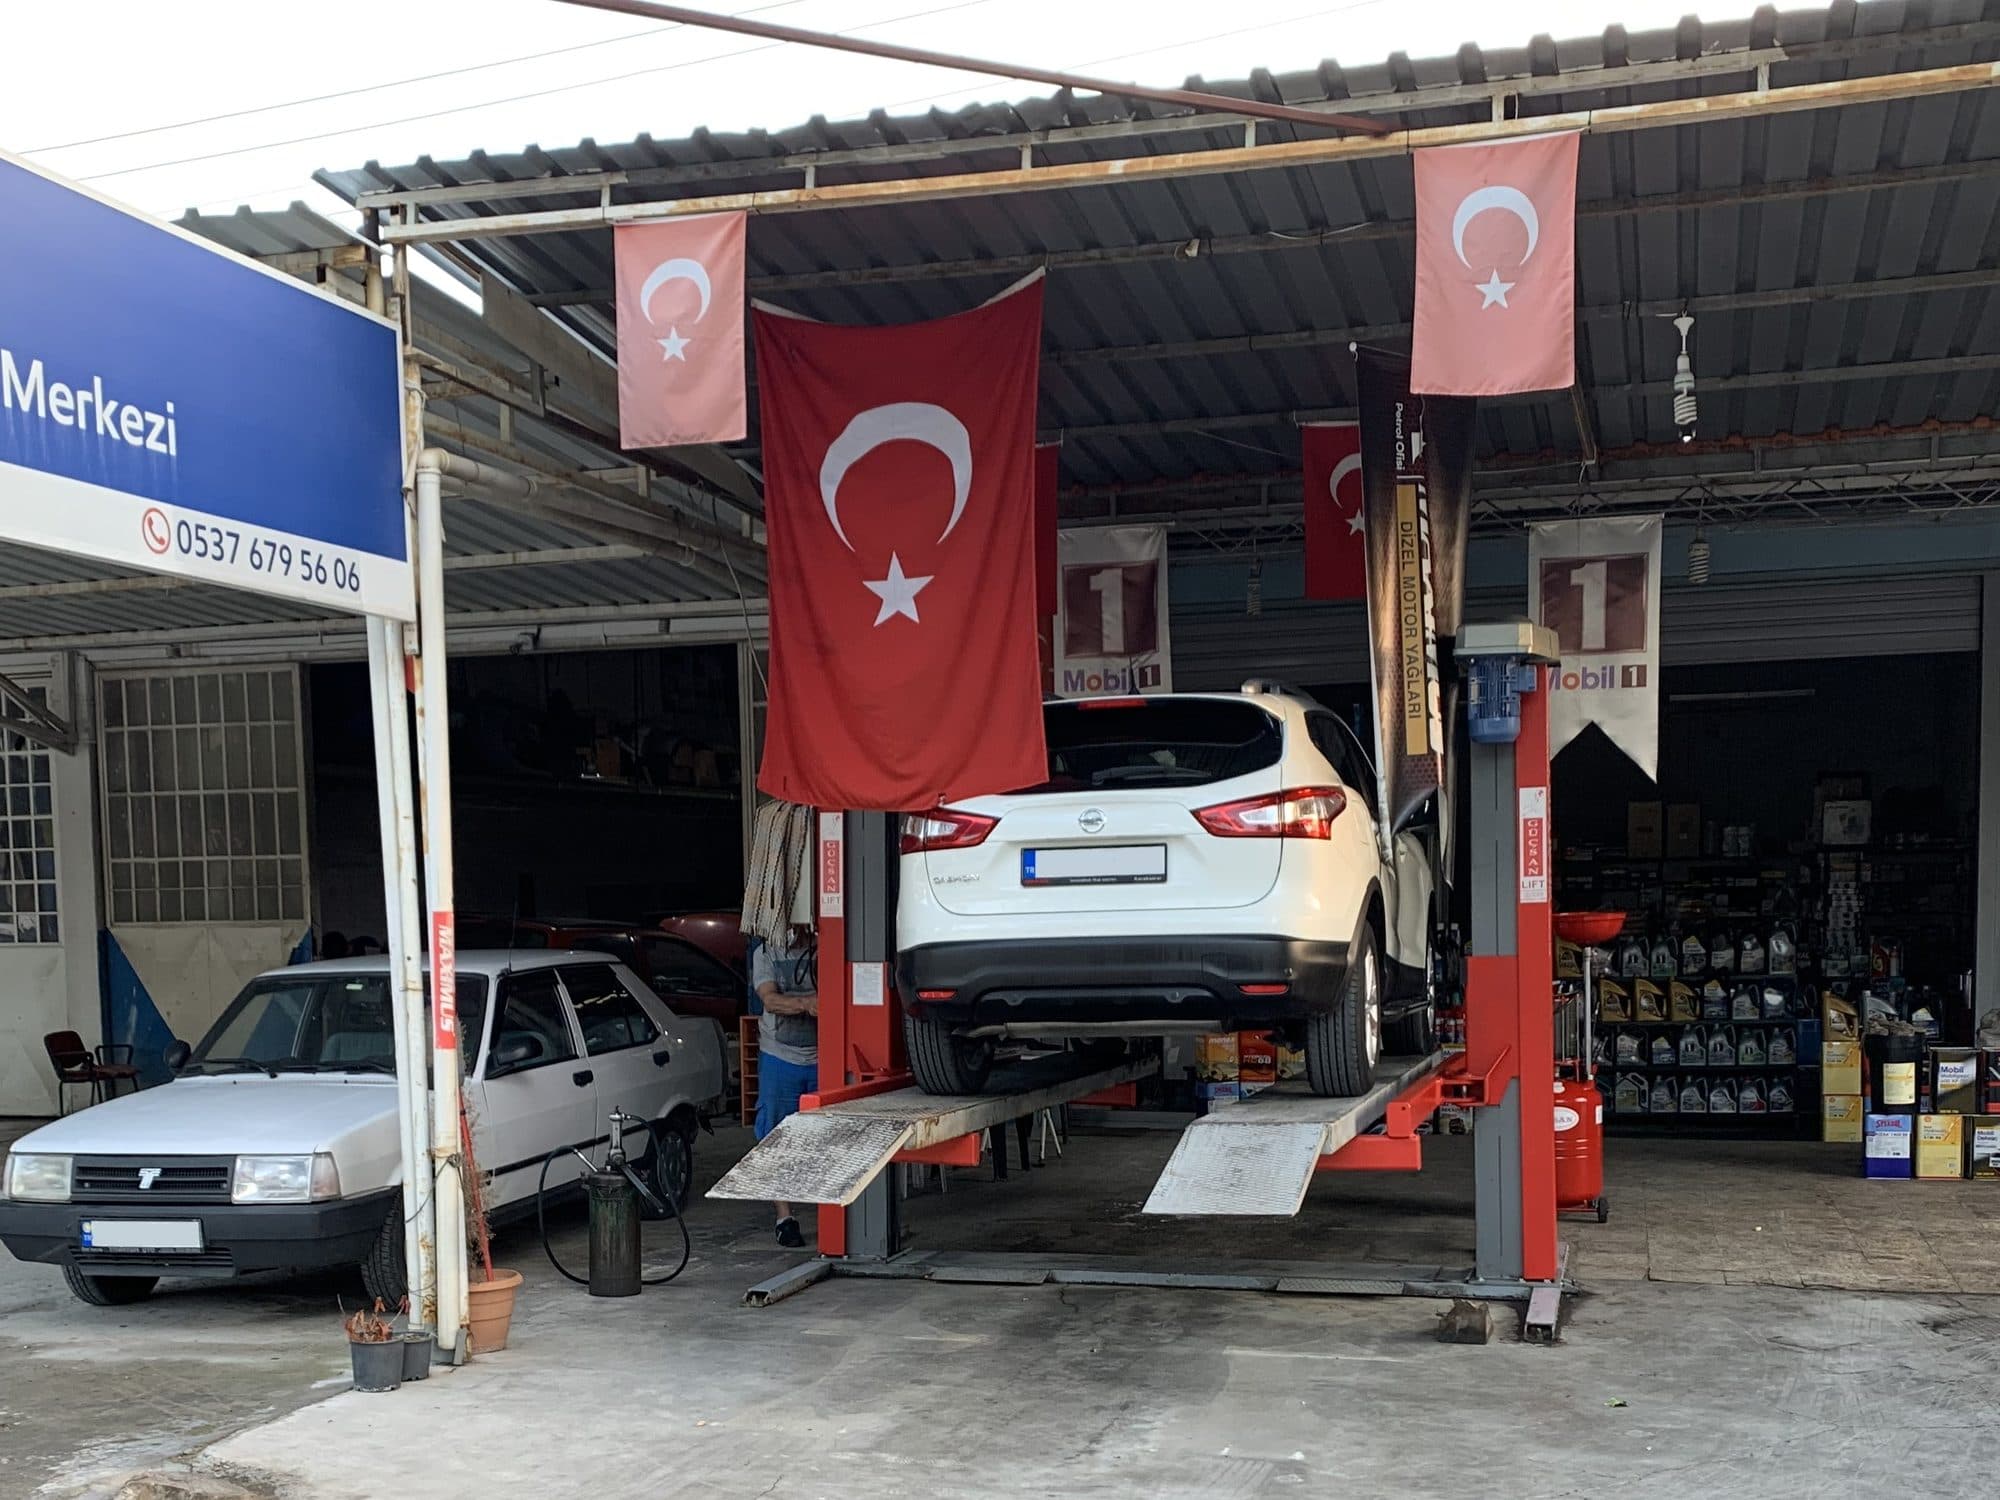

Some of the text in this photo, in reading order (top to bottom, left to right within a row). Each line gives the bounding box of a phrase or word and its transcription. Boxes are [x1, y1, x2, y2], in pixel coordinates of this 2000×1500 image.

[1, 348, 177, 457] Merkezi
[1395, 402, 1404, 440] Petrol
[177, 520, 360, 592] 0537 679 56 06
[1090, 568, 1125, 653] 1
[1401, 521, 1423, 719] DİZEL MOTOR YAĞLARI
[1570, 561, 1607, 649] 1
[1064, 667, 1132, 692] Mobi
[821, 896, 841, 905] LIFT
[1025, 866, 1035, 874] TR
[1521, 880, 1545, 889] LIFT
[438, 924, 456, 1036] MAXIMUS
